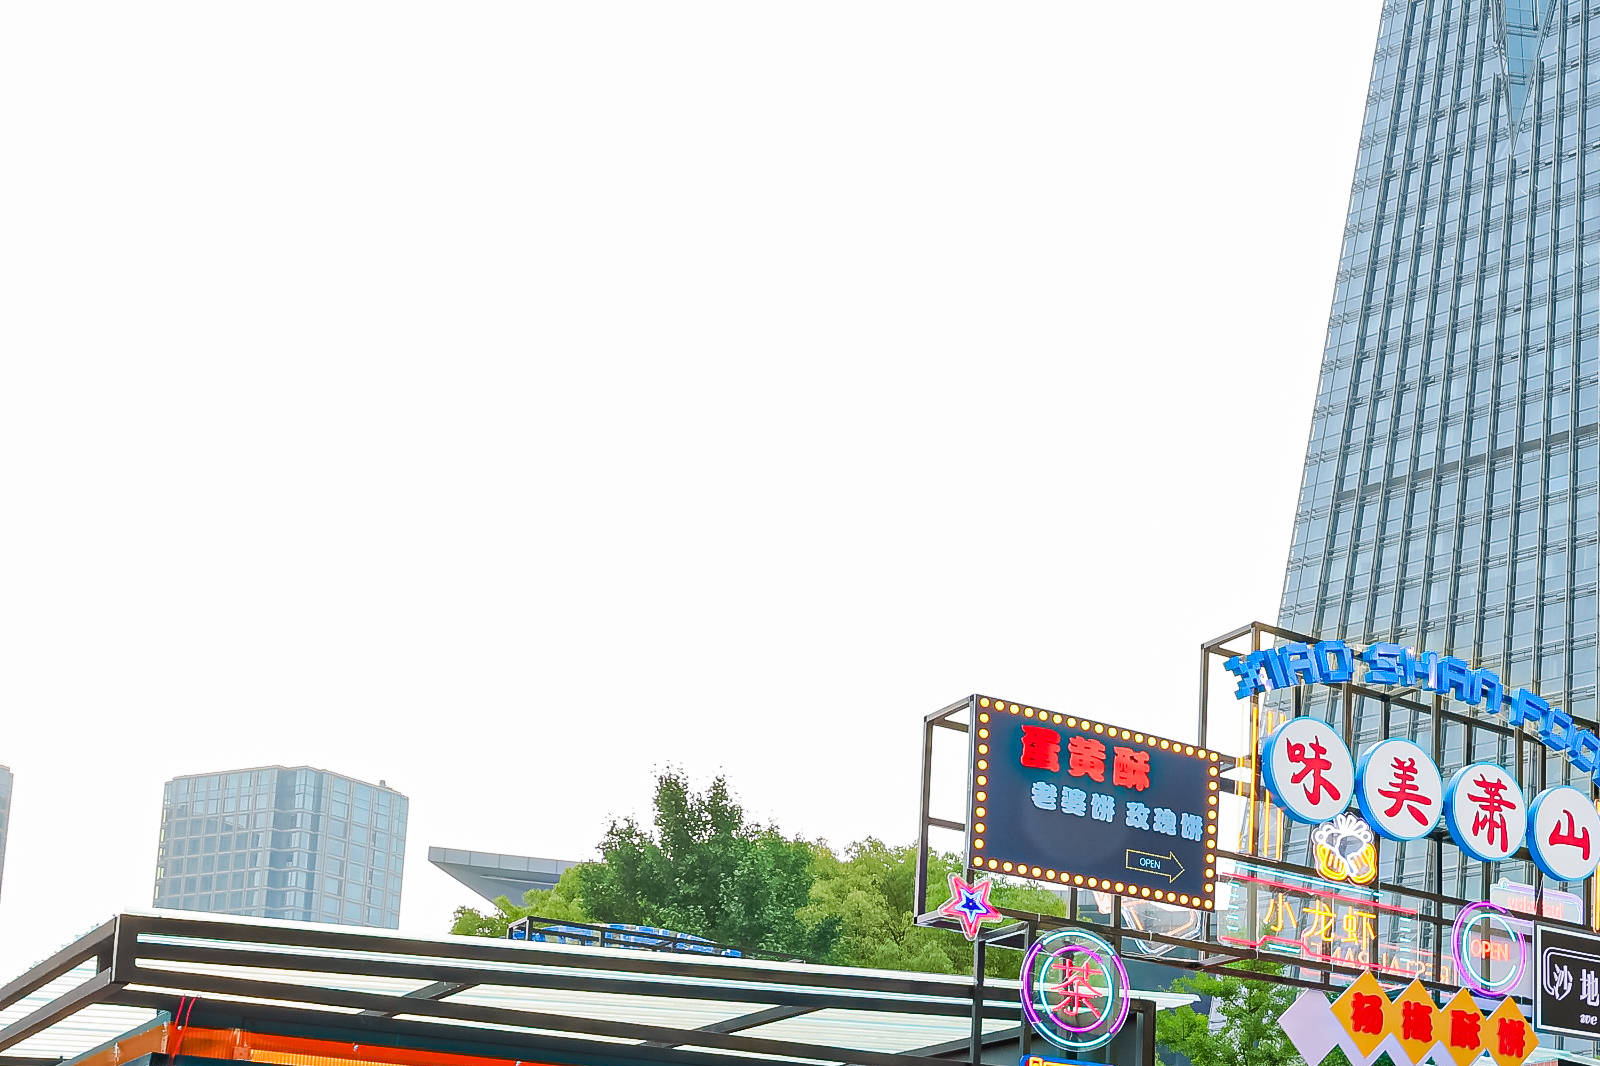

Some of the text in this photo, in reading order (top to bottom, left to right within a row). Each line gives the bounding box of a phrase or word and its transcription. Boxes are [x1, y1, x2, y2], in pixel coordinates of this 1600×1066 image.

[1224, 640, 1354, 700] XIAO
[1021, 725, 1151, 791] 蛋黄酥
[1030, 781, 1117, 823] 老婆饼
[1284, 734, 1592, 862] 味美萧山
[1139, 857, 1162, 870] OPEN
[1263, 892, 1378, 952] 小龙虾
[1470, 938, 1511, 962] OPEN
[1050, 958, 1104, 1020] 茶
[1350, 991, 1526, 1059] 杨梅酥饼
[1579, 1013, 1598, 1026] we
